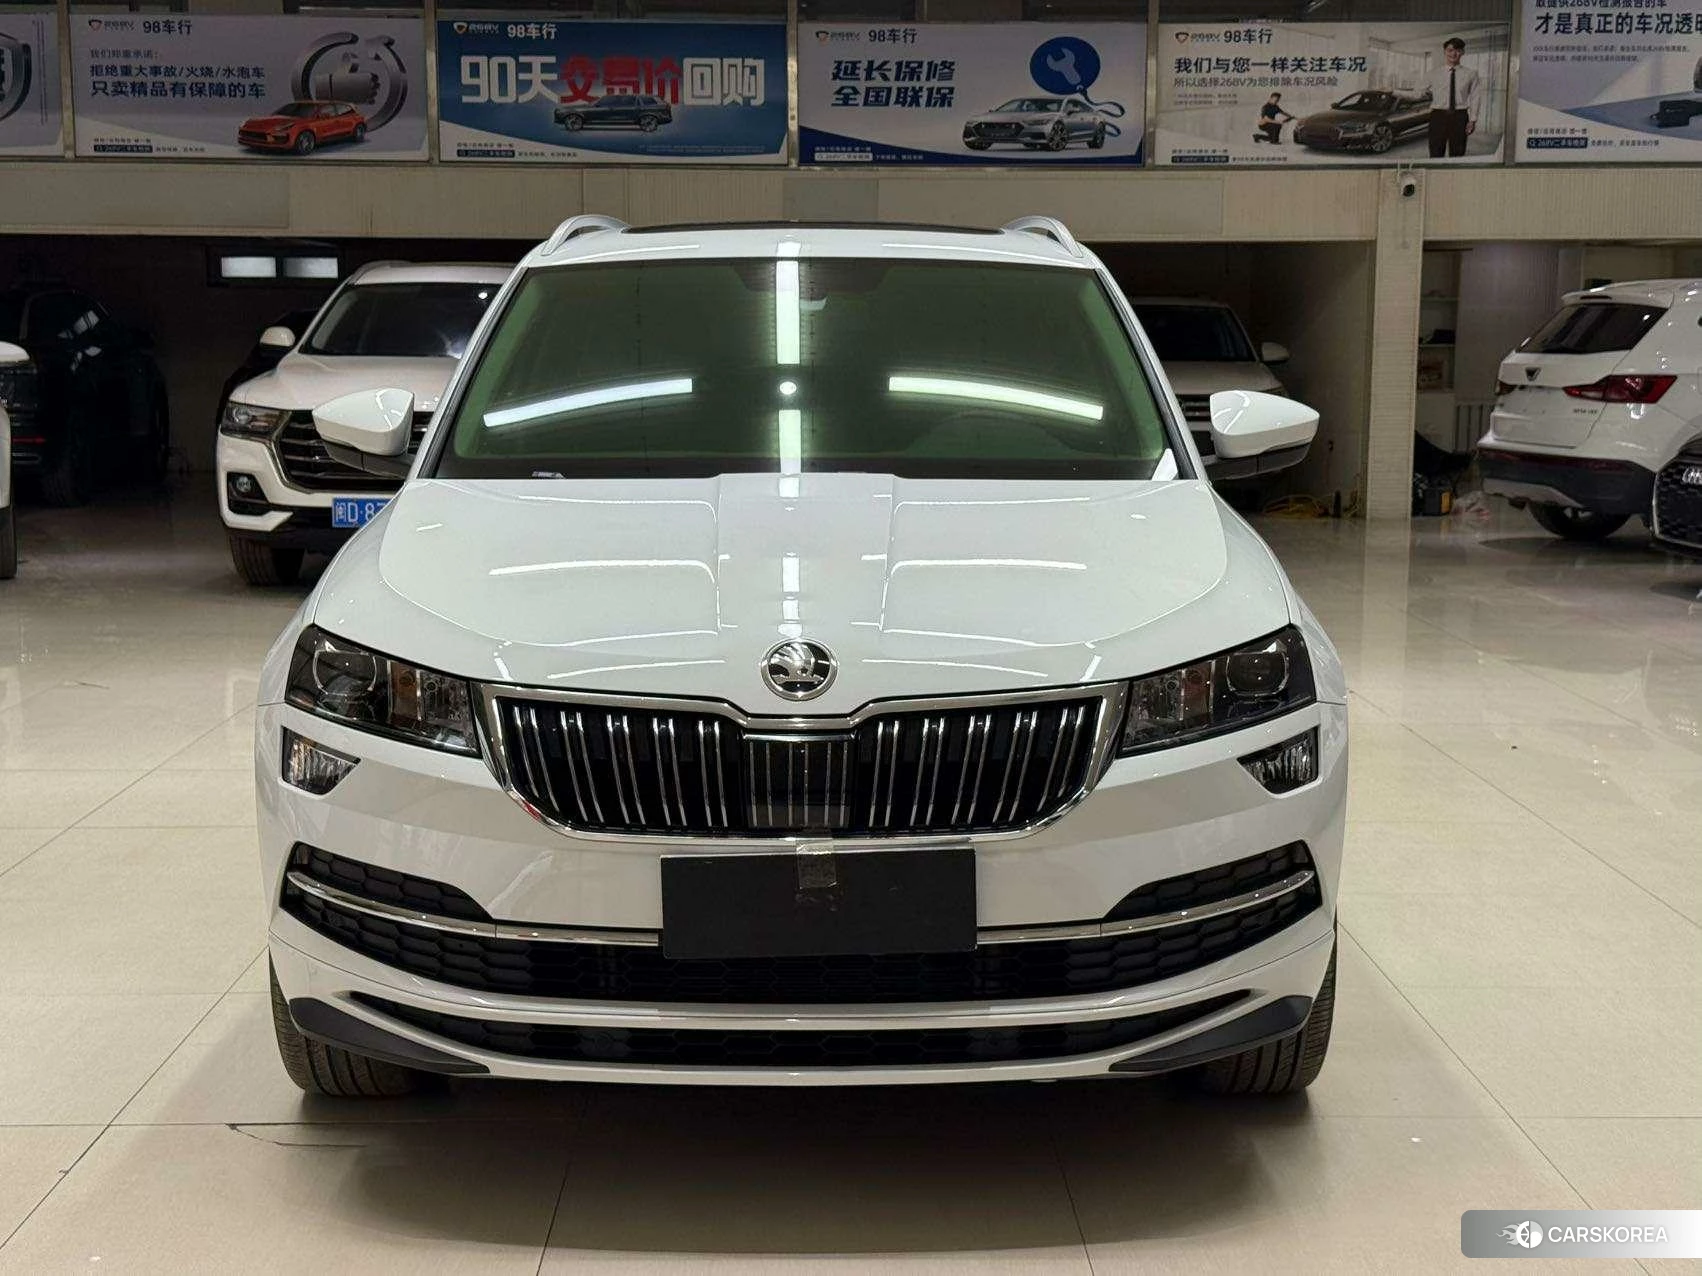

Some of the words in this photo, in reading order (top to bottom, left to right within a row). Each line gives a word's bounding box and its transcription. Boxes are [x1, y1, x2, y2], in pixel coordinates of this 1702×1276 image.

[143, 19, 193, 35] 98车行
[507, 23, 558, 40] 98车行
[868, 28, 918, 44] 98车行
[1223, 28, 1273, 44] 98车行
[89, 64, 266, 80] 拒绝重大事故/火烧/水泡车
[831, 59, 956, 82] 延长保修
[1173, 55, 1368, 74] 我们与您一样关注车况
[460, 54, 766, 106] 90天交易价回购
[91, 80, 266, 99] 只卖精品有保障的车
[831, 85, 956, 108] 全国联保
